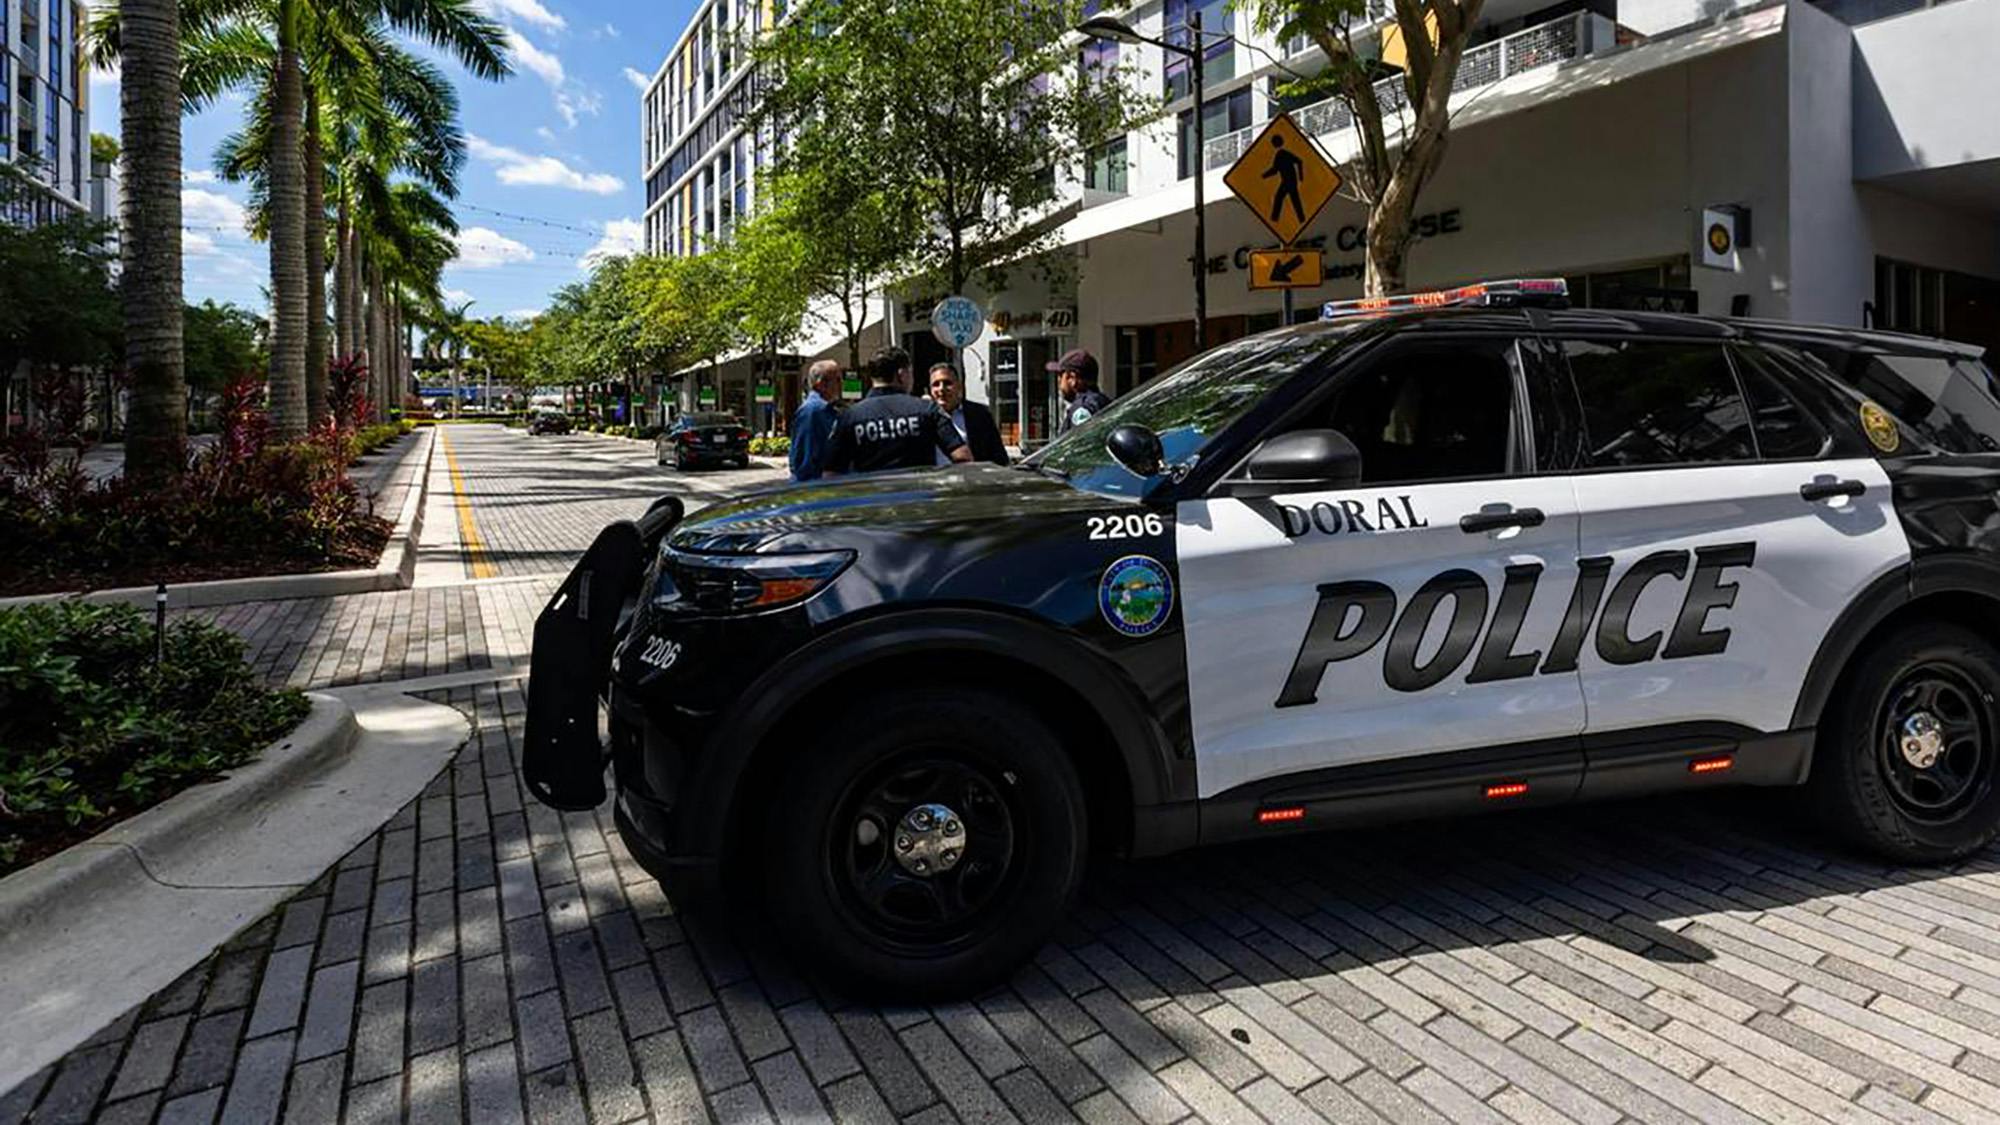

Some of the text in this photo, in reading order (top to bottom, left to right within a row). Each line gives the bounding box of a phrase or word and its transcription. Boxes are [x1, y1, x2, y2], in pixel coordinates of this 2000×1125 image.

[1336, 208, 1462, 252] CRSE
[854, 416, 921, 446] POLICE
[1087, 513, 1163, 540] 2206
[1276, 495, 1429, 538] DORAL
[1274, 541, 1757, 708] POLICE
[640, 634, 682, 670] 2206
